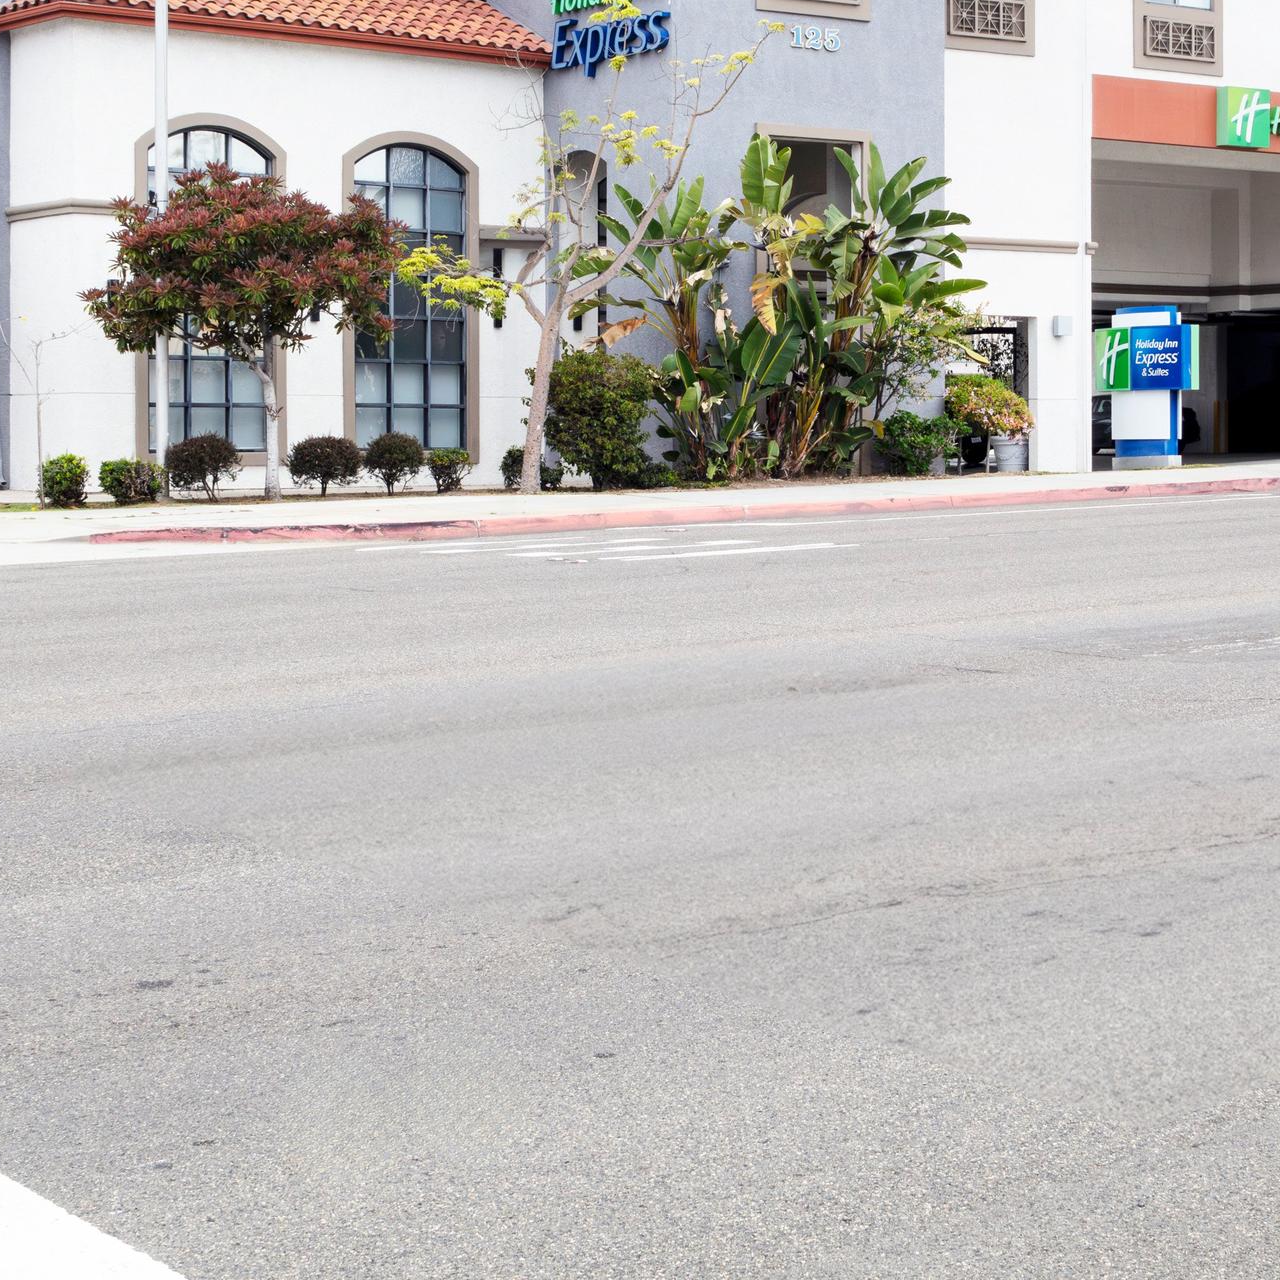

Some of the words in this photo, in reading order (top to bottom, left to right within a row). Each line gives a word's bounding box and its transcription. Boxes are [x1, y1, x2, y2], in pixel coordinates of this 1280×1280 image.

[550, 10, 671, 79] Express
[790, 25, 841, 52] 125
[1135, 338, 1164, 351] Holiday
[1164, 338, 1179, 348] Inn
[1135, 350, 1178, 367] Express
[1141, 368, 1147, 377] &
[1147, 368, 1169, 377] Suites
